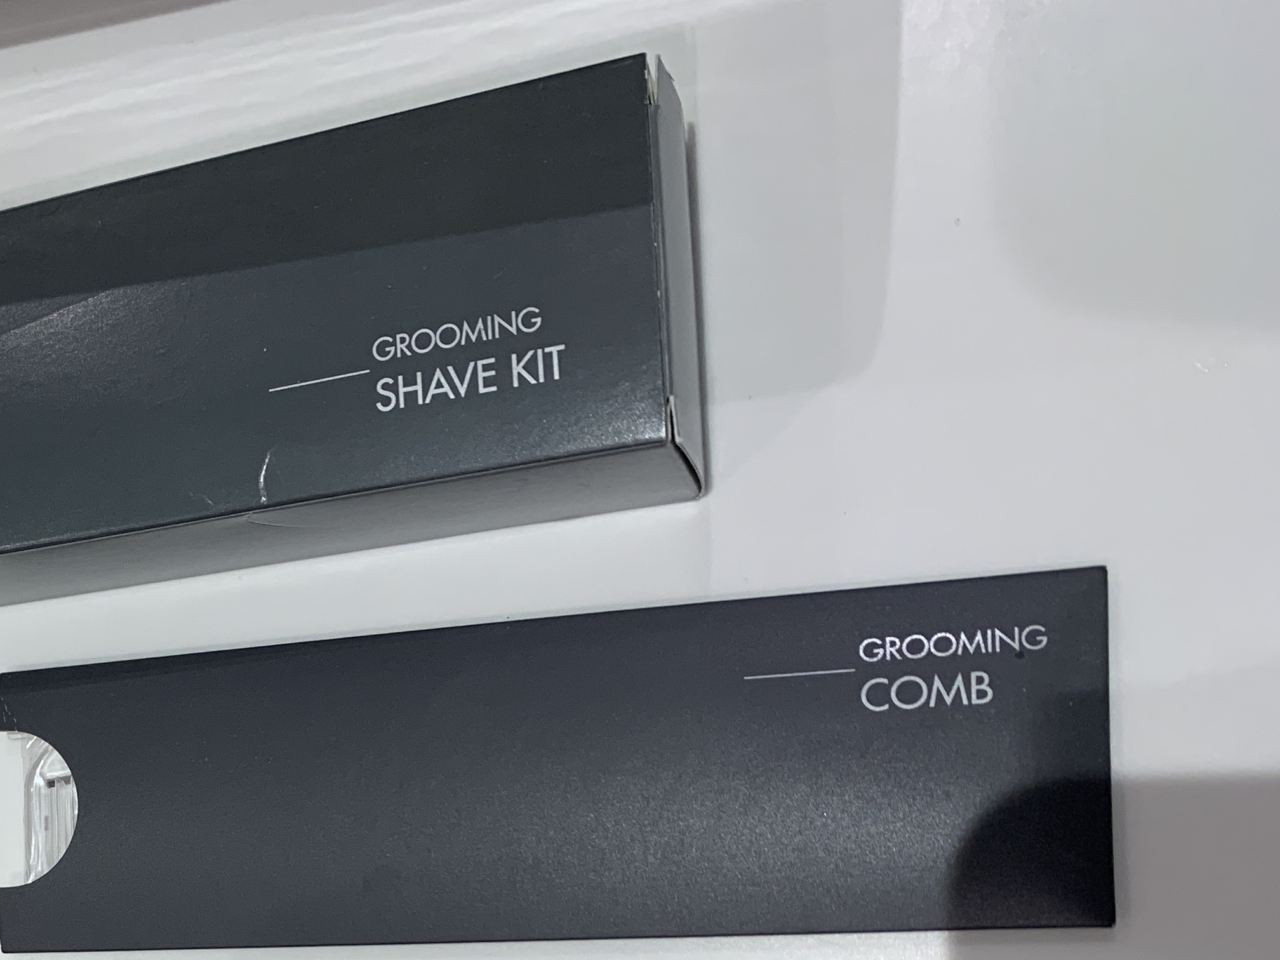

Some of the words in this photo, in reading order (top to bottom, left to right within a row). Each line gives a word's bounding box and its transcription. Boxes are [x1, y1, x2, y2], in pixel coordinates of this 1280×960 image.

[372, 306, 542, 361] GROOMING
[375, 357, 498, 412] SHAVE
[511, 344, 566, 388] KIT
[858, 624, 1049, 663] GROOMING
[860, 671, 994, 712] COMB
